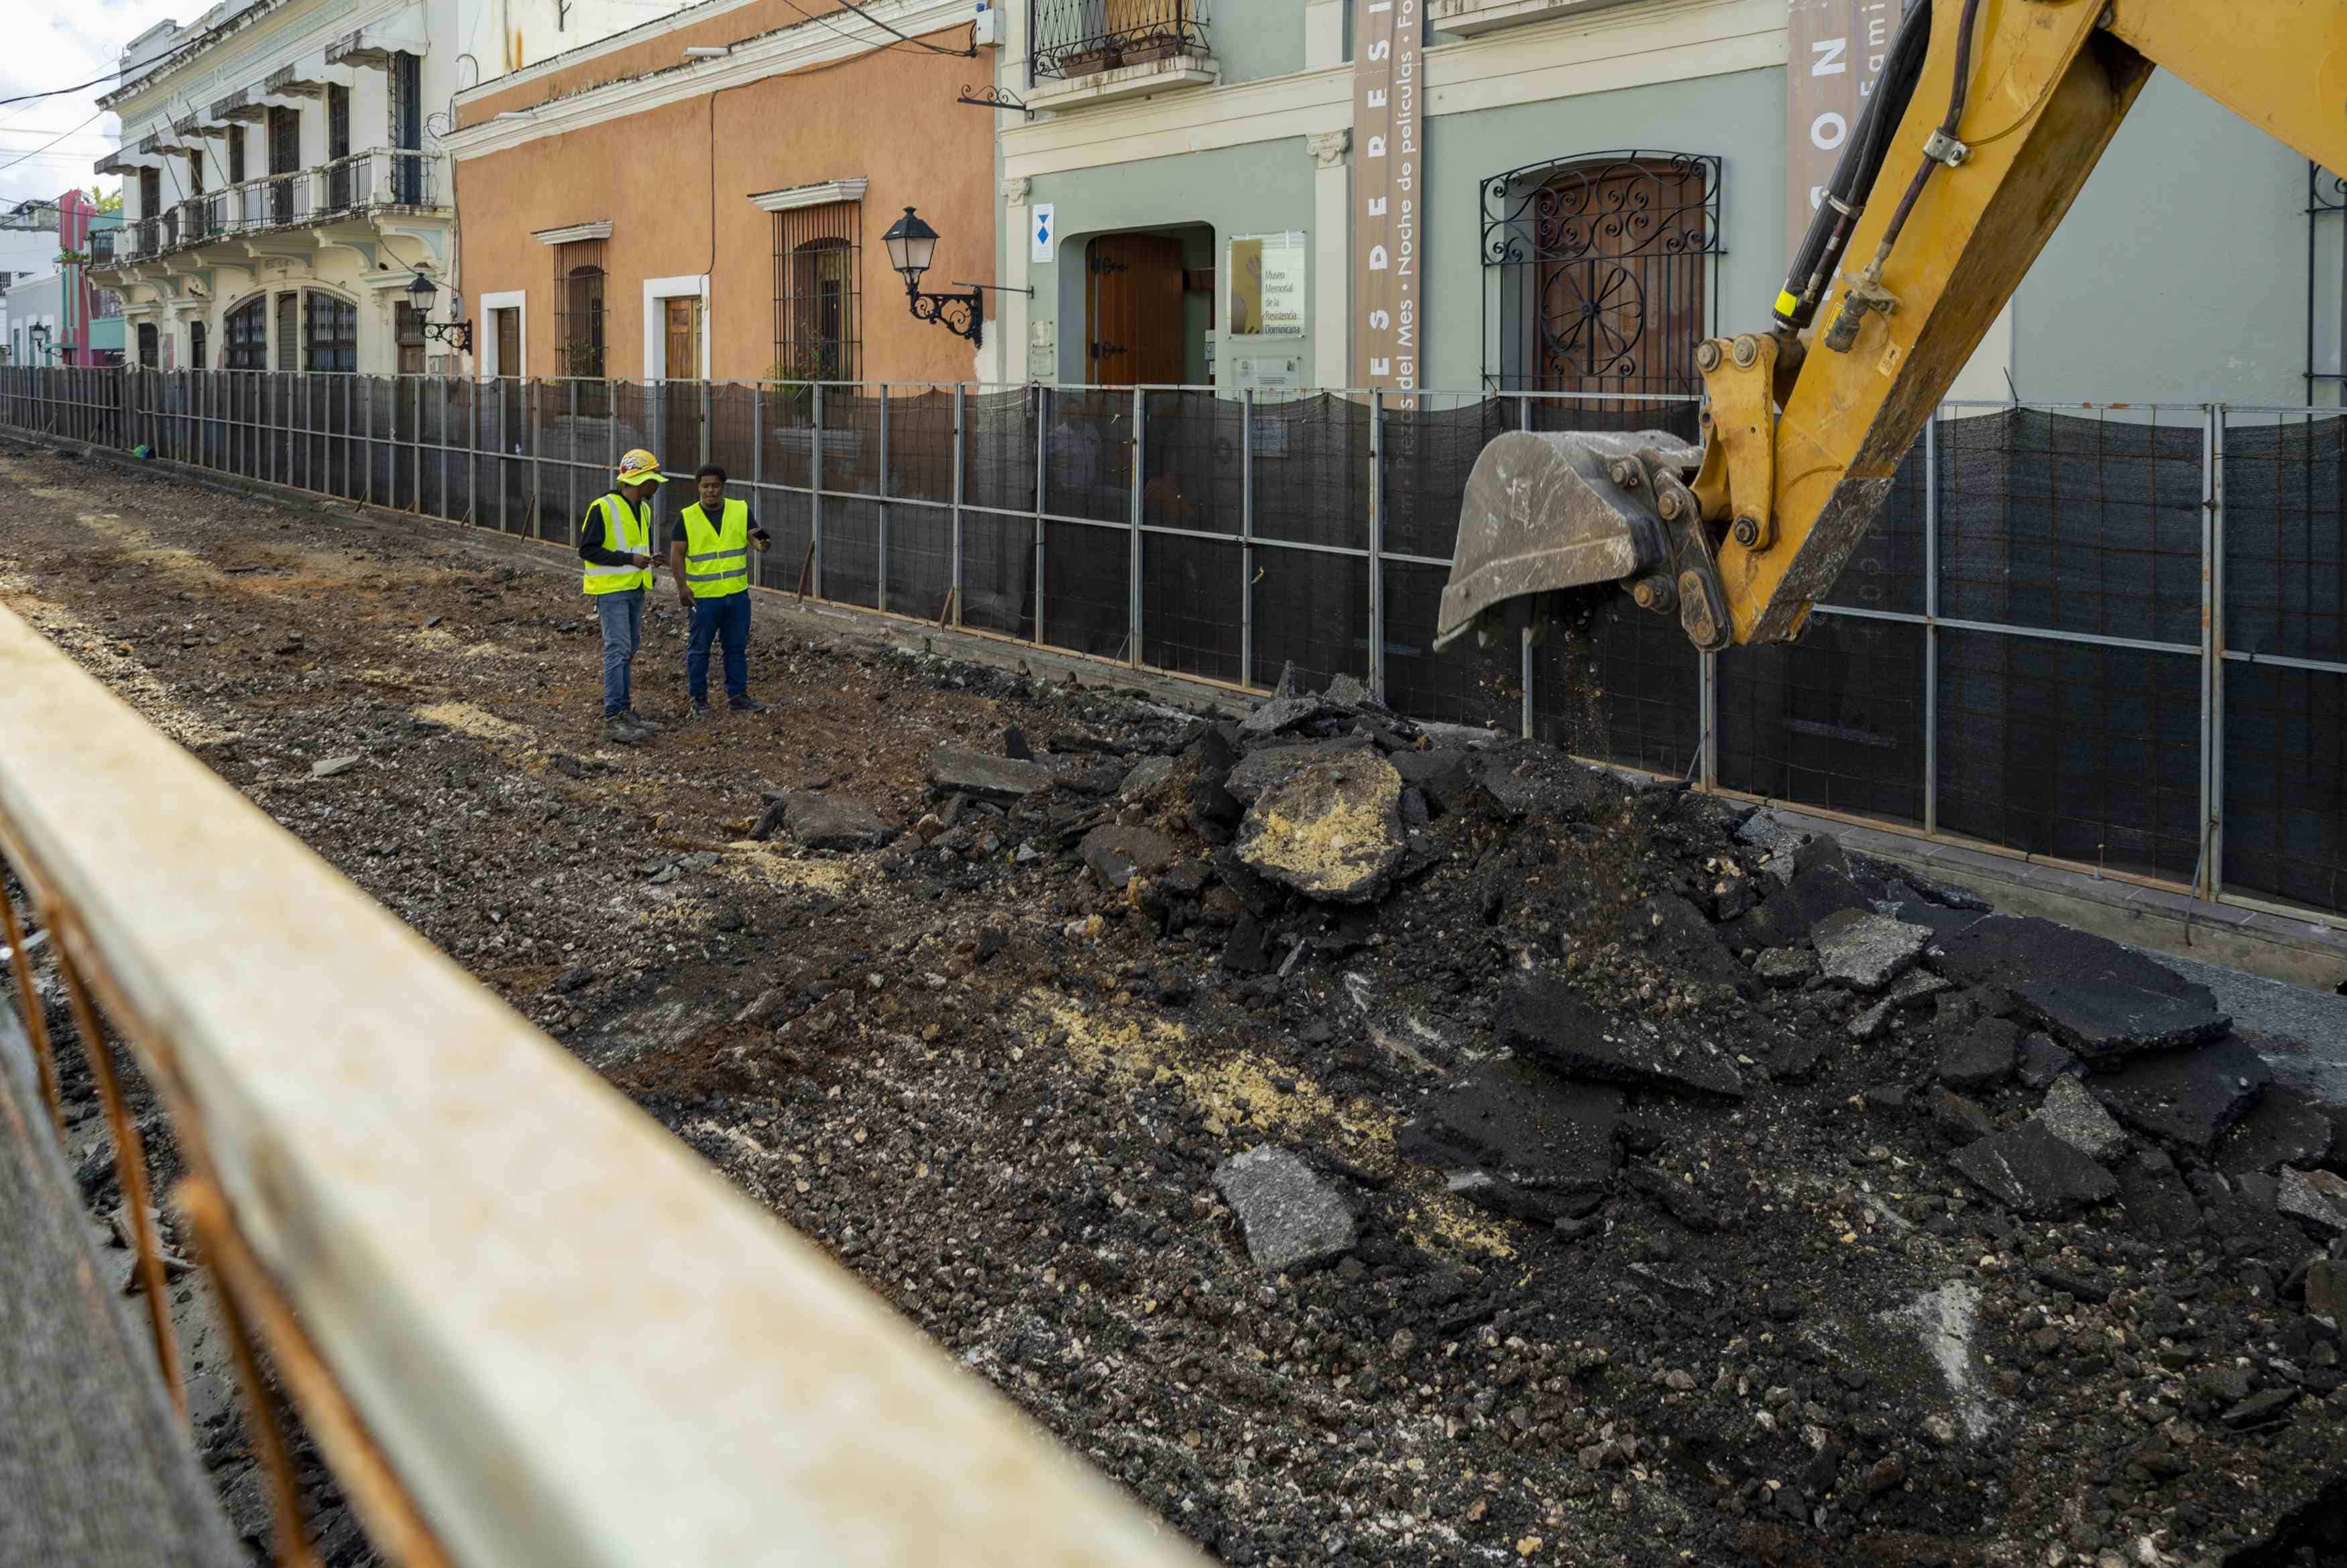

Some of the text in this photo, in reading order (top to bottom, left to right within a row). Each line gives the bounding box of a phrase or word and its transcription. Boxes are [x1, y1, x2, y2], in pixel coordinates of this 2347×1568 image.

[1395, 50, 1417, 154] películas
[1397, 162, 1412, 191] de
[1397, 199, 1412, 276] Noche
[1265, 270, 1285, 280] Museo
[1265, 282, 1294, 294] Memorial
[1265, 297, 1273, 307] de
[1265, 310, 1298, 321] Resistencia
[1265, 324, 1300, 334] Dominicana
[1397, 300, 1413, 347] Mes
[1369, 309, 1389, 376] ES
[1395, 355, 1414, 390] del
